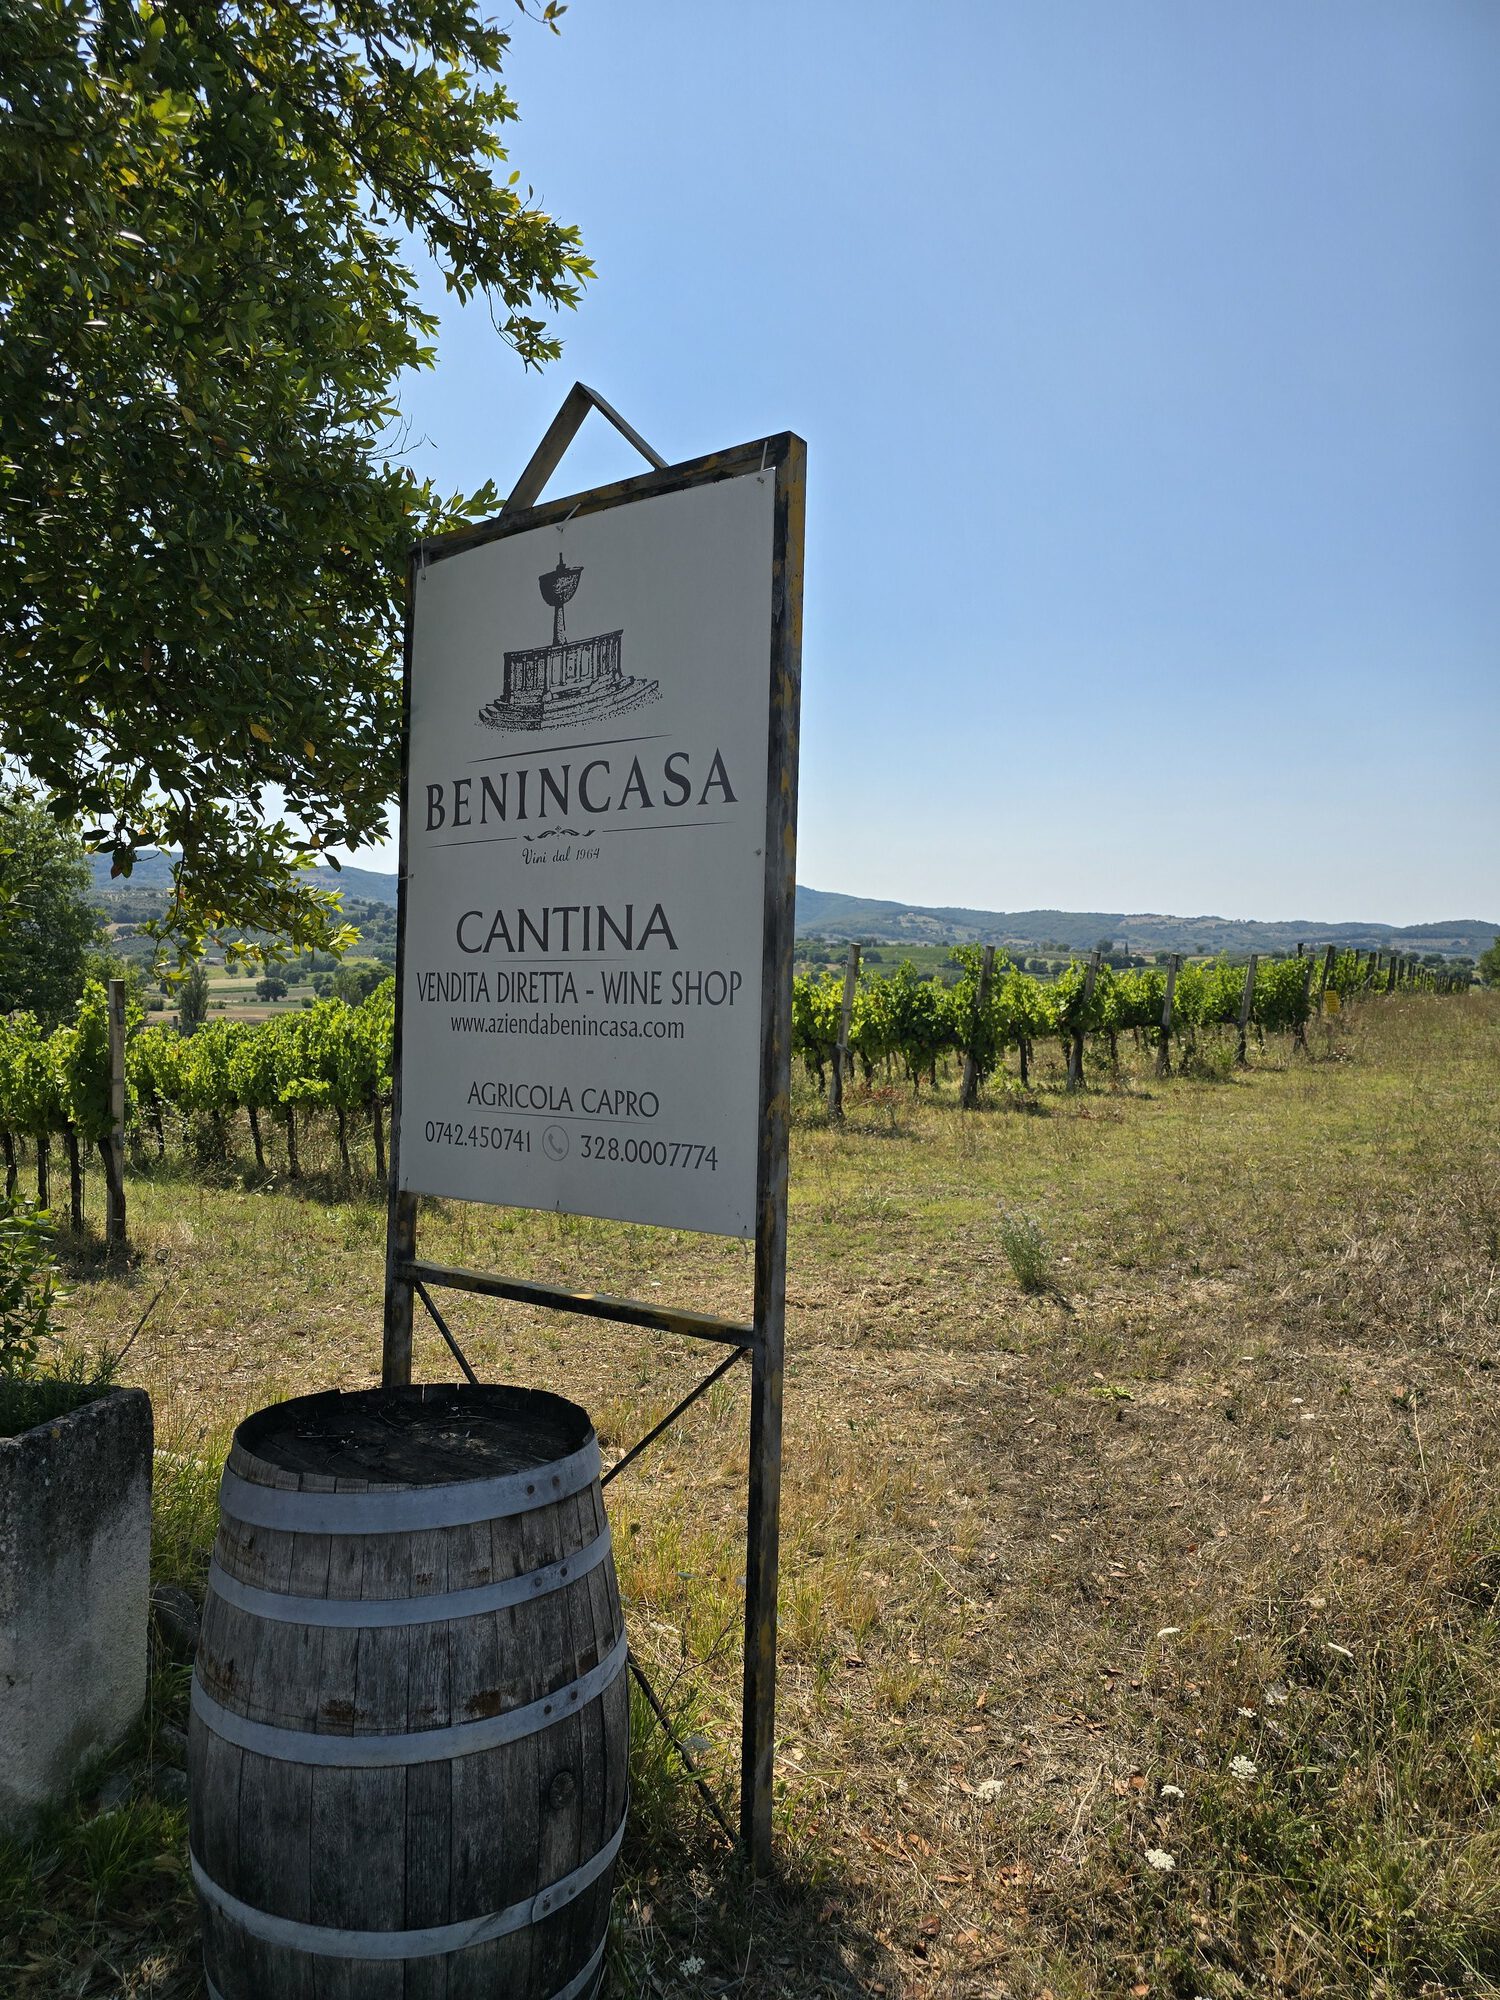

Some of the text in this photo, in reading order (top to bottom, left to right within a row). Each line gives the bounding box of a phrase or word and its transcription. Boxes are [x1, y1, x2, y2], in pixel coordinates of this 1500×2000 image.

[425, 747, 739, 832] BENINCASA
[522, 845, 600, 864] Vini dal 1964
[456, 903, 679, 953] CANTINA
[417, 972, 490, 1003] VENDITA
[497, 971, 579, 1004] DIRETTA
[601, 970, 662, 1005] WINE
[671, 970, 743, 1006] SHOP
[451, 1013, 685, 1039] www.aziendabenincasa.com
[467, 1081, 660, 1118] AGRICOLA CAPRO
[425, 1121, 719, 1172] 0742.450741 328.0007774
